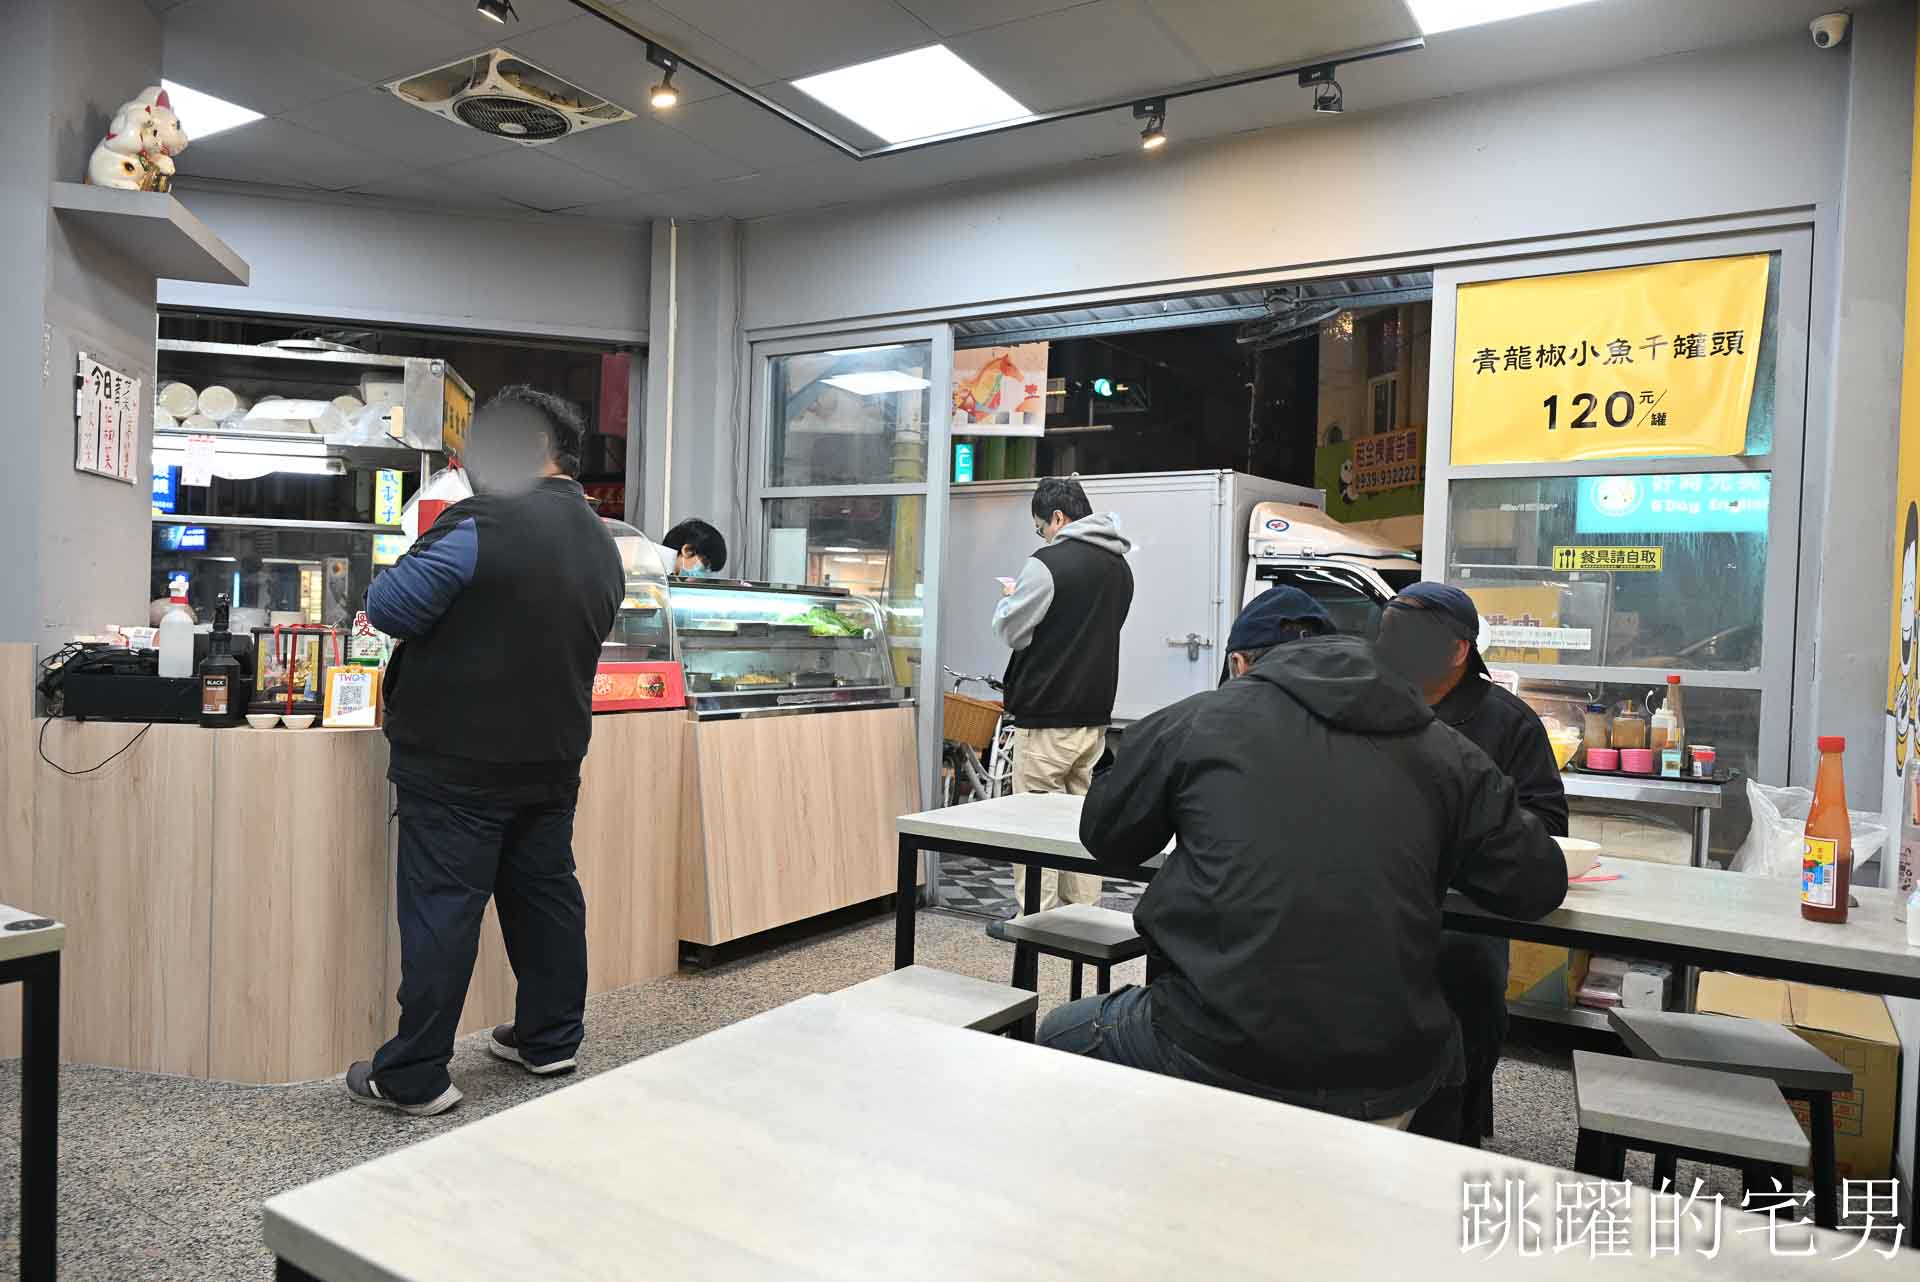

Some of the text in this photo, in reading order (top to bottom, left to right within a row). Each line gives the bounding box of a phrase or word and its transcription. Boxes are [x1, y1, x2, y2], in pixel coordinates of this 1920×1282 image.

[1580, 550, 1656, 563] 餐具請自取
